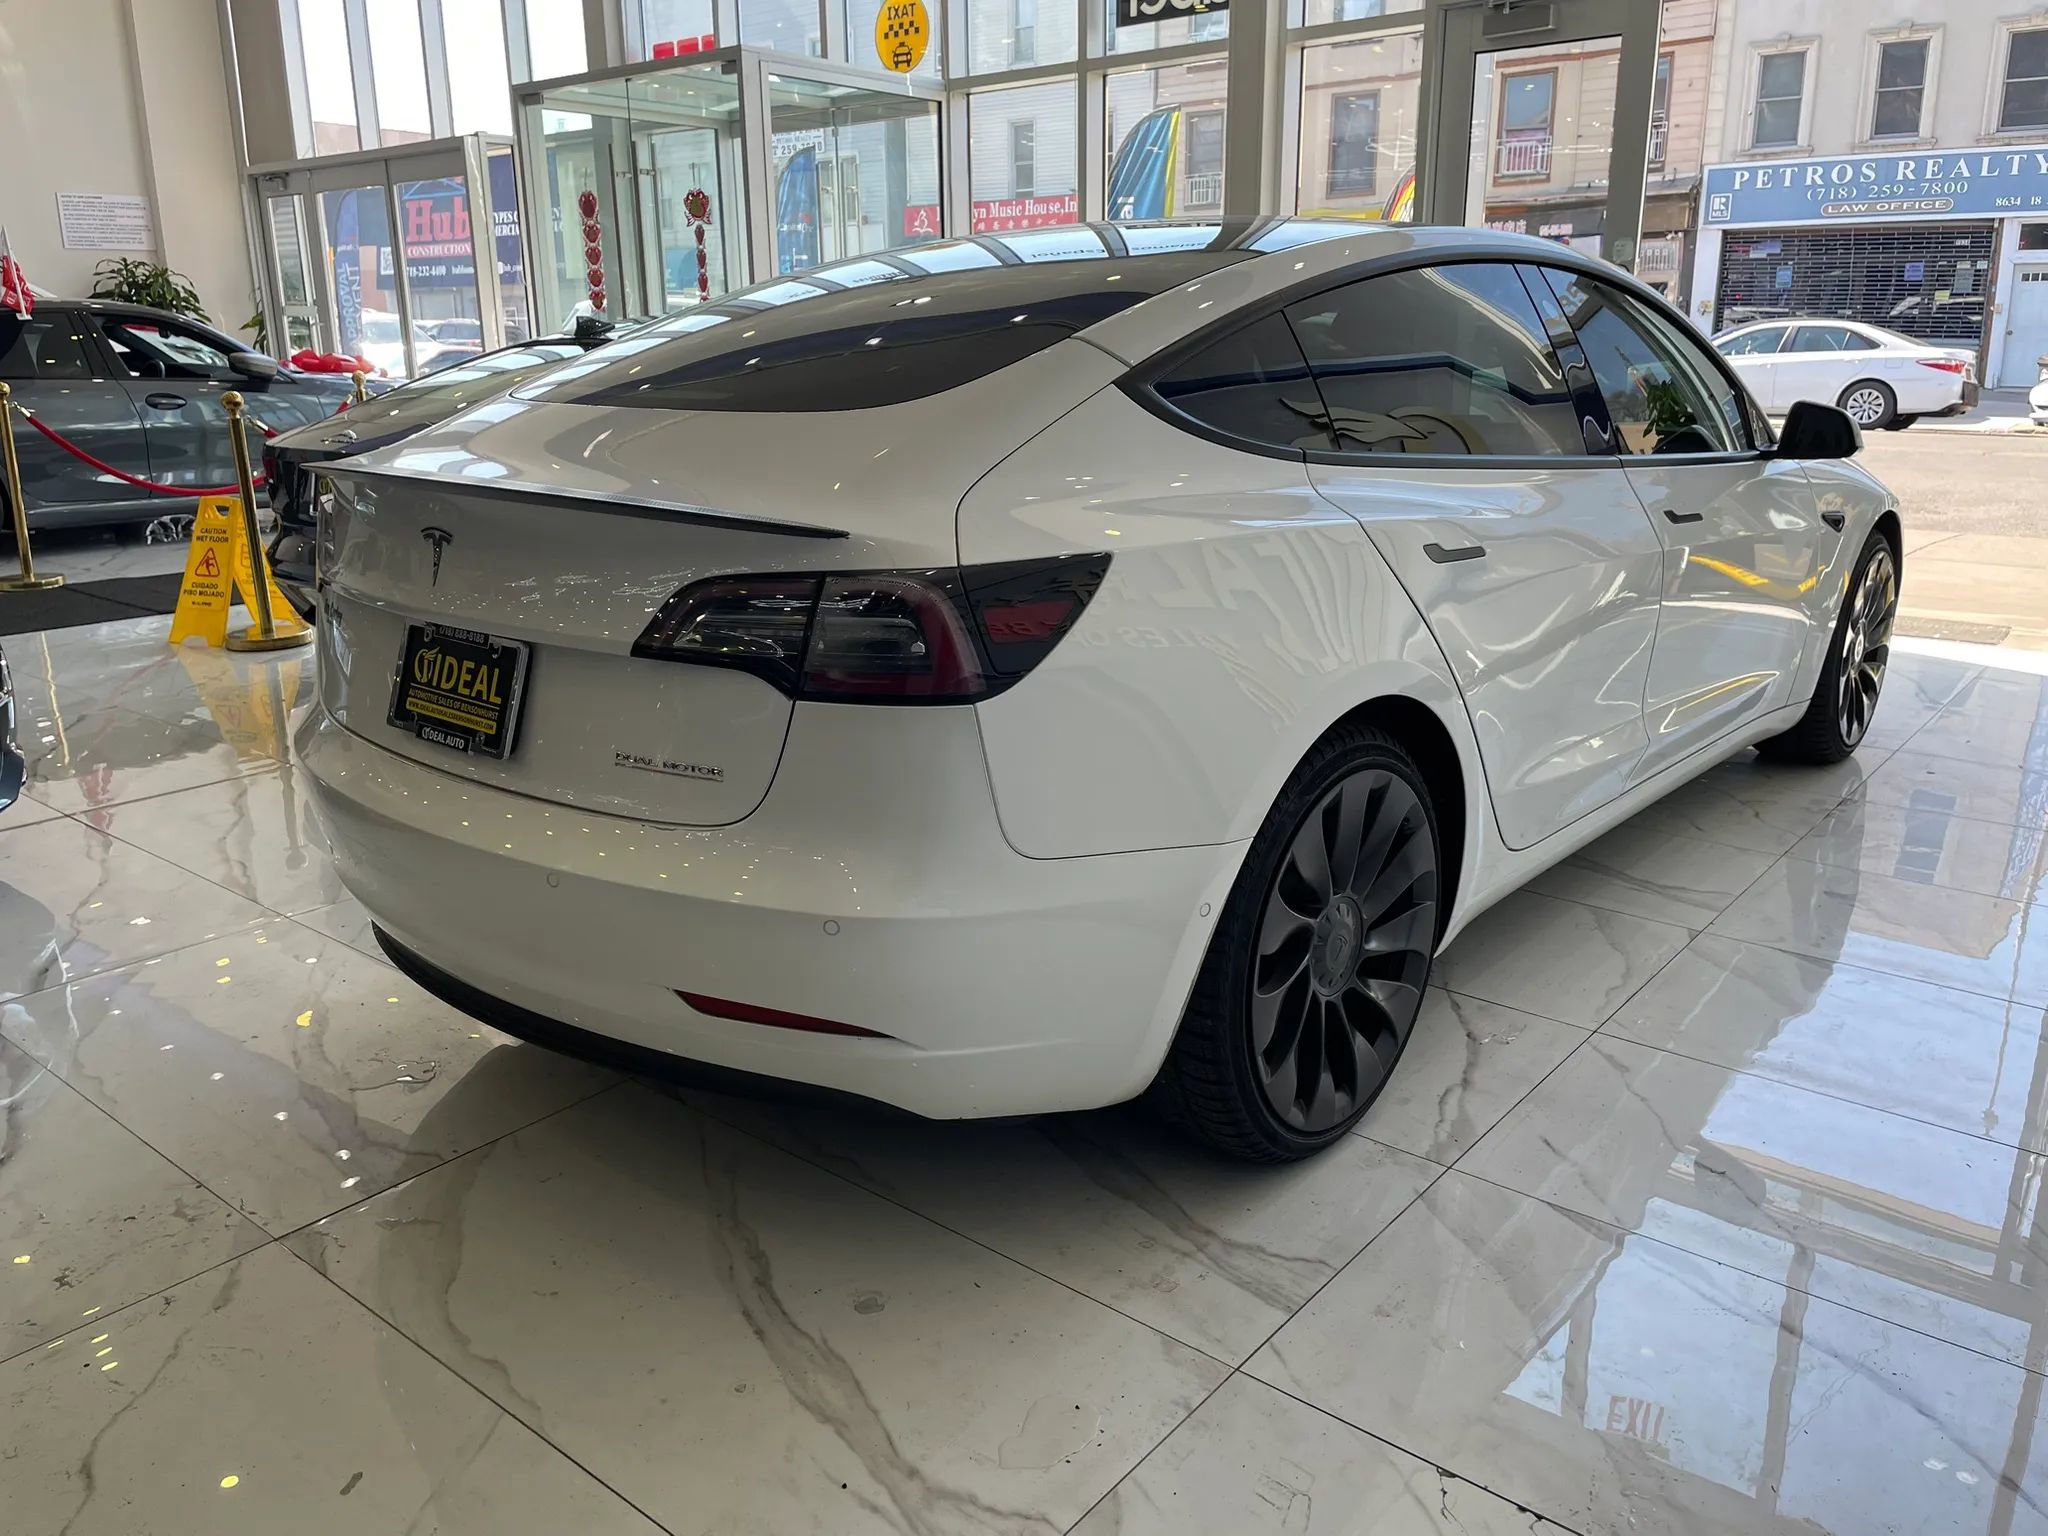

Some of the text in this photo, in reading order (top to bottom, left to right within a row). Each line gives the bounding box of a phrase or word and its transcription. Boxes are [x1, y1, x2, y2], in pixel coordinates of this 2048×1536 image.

[1733, 153, 2048, 190] PETROS REALTY
[1807, 181, 1968, 201] (718) 259-7800
[989, 200, 1022, 218] Music
[1828, 200, 1946, 213] LAW OFFICE
[1995, 196, 2021, 207] 8634
[406, 196, 471, 242] Hub
[200, 527, 227, 535] CAUTION
[209, 535, 229, 543] FLOOR
[183, 587, 225, 598] PISO MOJADO
[432, 653, 502, 704] IDEAL
[408, 687, 438, 704] AUTOMOTIVE
[438, 696, 453, 707] SALES
[446, 736, 465, 749] AUTO
[615, 751, 724, 777] DUAL MOTOR
